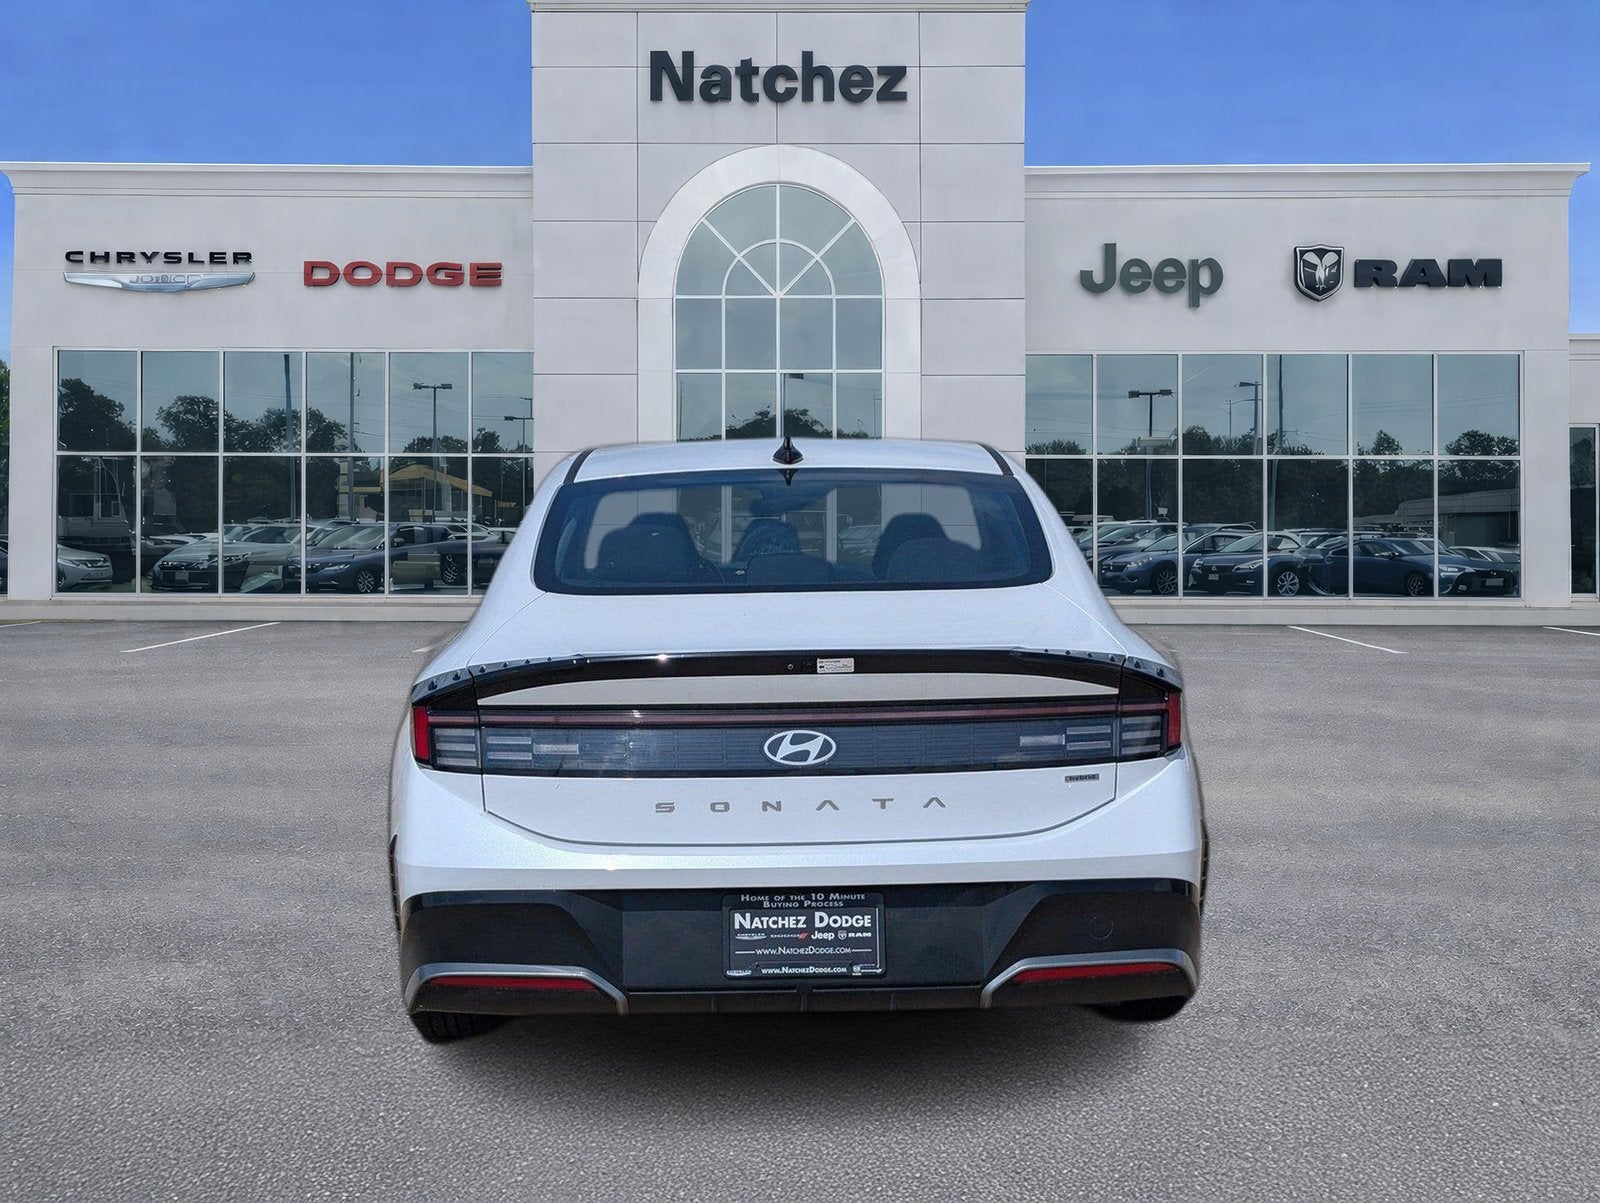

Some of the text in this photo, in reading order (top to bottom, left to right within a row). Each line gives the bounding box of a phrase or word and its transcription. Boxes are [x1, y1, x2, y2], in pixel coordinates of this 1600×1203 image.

[650, 50, 908, 103] Natchez
[65, 250, 253, 265] CHRYSLER
[304, 261, 502, 287] DODGE
[1079, 242, 1224, 309] Jeep
[1354, 258, 1503, 288] RAM
[654, 796, 947, 814] SONATA
[811, 931, 835, 940] Jeep
